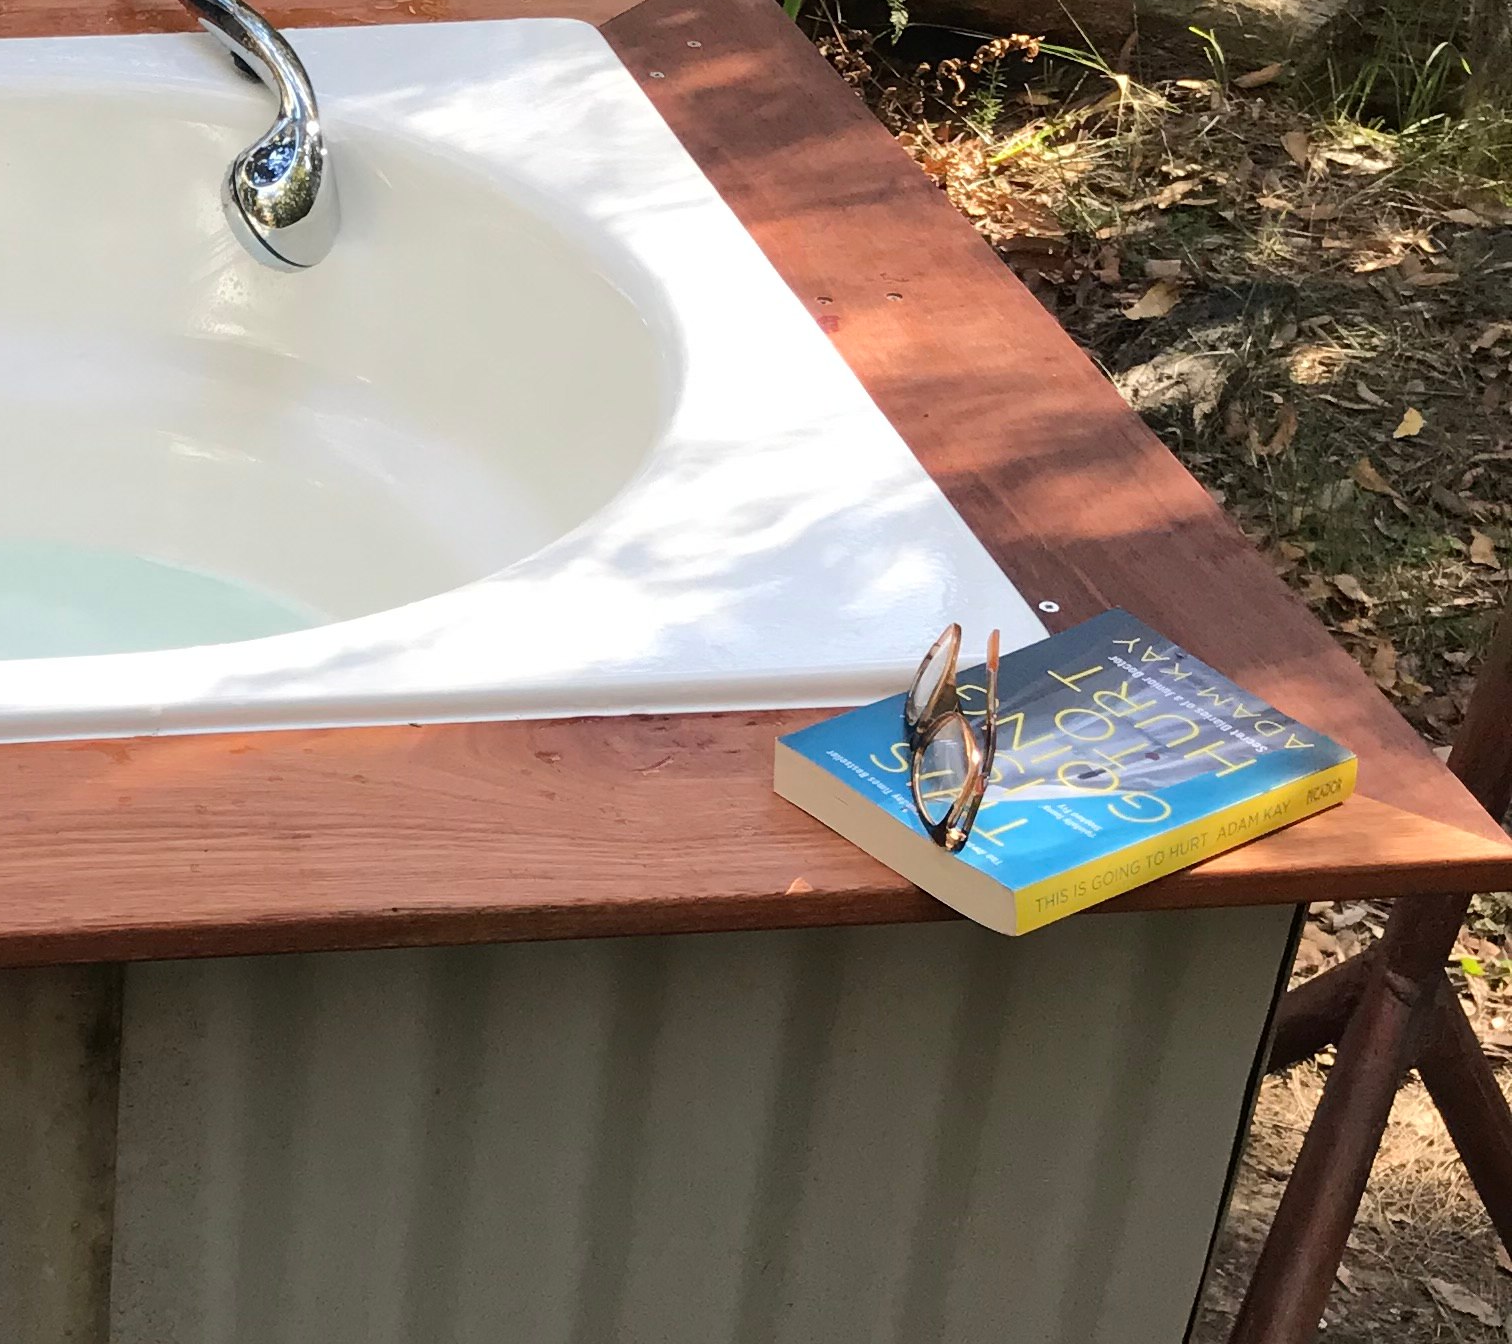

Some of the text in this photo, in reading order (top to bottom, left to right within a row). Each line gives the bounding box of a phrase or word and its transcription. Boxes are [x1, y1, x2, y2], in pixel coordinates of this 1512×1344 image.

[1108, 655, 1145, 679] Doctor
[1112, 637, 1315, 749] ADAM KAY
[1142, 676, 1177, 701] Junior
[1182, 699, 1196, 711] of
[1047, 665, 1257, 778] HURT
[1194, 707, 1232, 732] Diaries
[1054, 707, 1150, 771] TO
[1230, 728, 1268, 753] Secret
[825, 749, 870, 779] Bestseller
[869, 775, 894, 796] Times
[1035, 887, 1069, 913] THIS
[1073, 882, 1088, 898] IS
[1091, 860, 1141, 891] GOING
[1146, 850, 1166, 870] TO
[1169, 832, 1209, 858] HURT
[1216, 815, 1260, 841] ADAM
[1263, 799, 1292, 822] KAY
